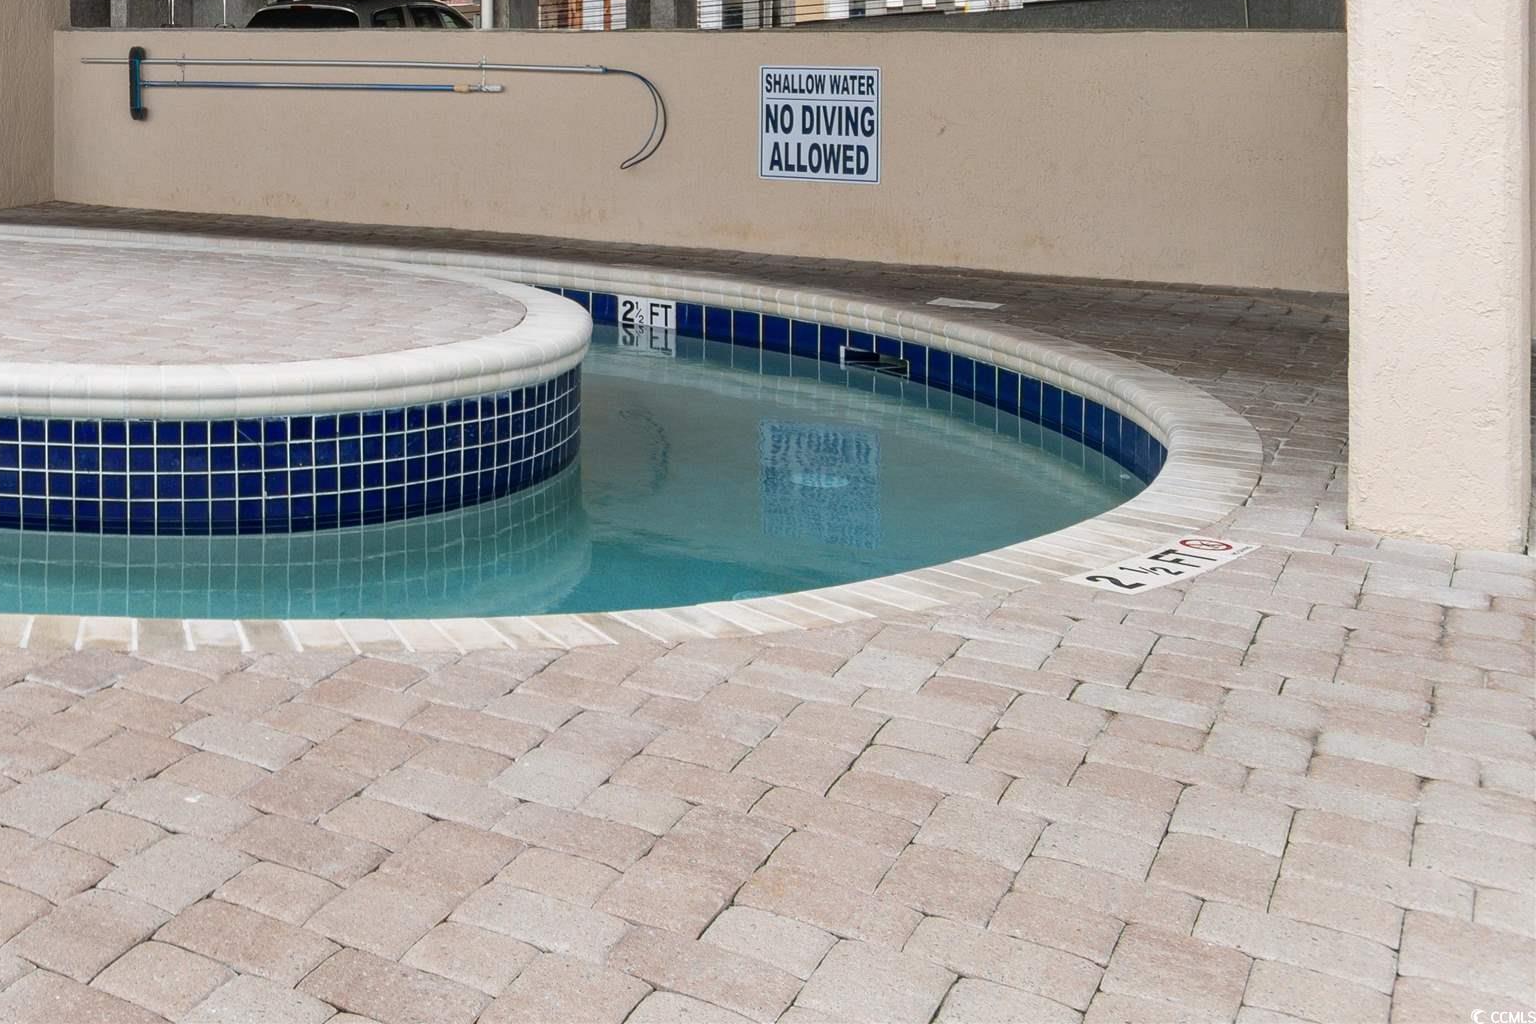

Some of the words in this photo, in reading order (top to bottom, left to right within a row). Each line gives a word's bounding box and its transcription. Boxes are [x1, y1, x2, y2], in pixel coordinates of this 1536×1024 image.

[765, 74, 825, 94] SHALLOW
[830, 74, 874, 95] WATER
[766, 104, 794, 134] NO
[802, 105, 874, 137] DIVING
[769, 142, 869, 175] ALLOWED
[650, 303, 672, 326] FT
[1148, 549, 1217, 568] FT
